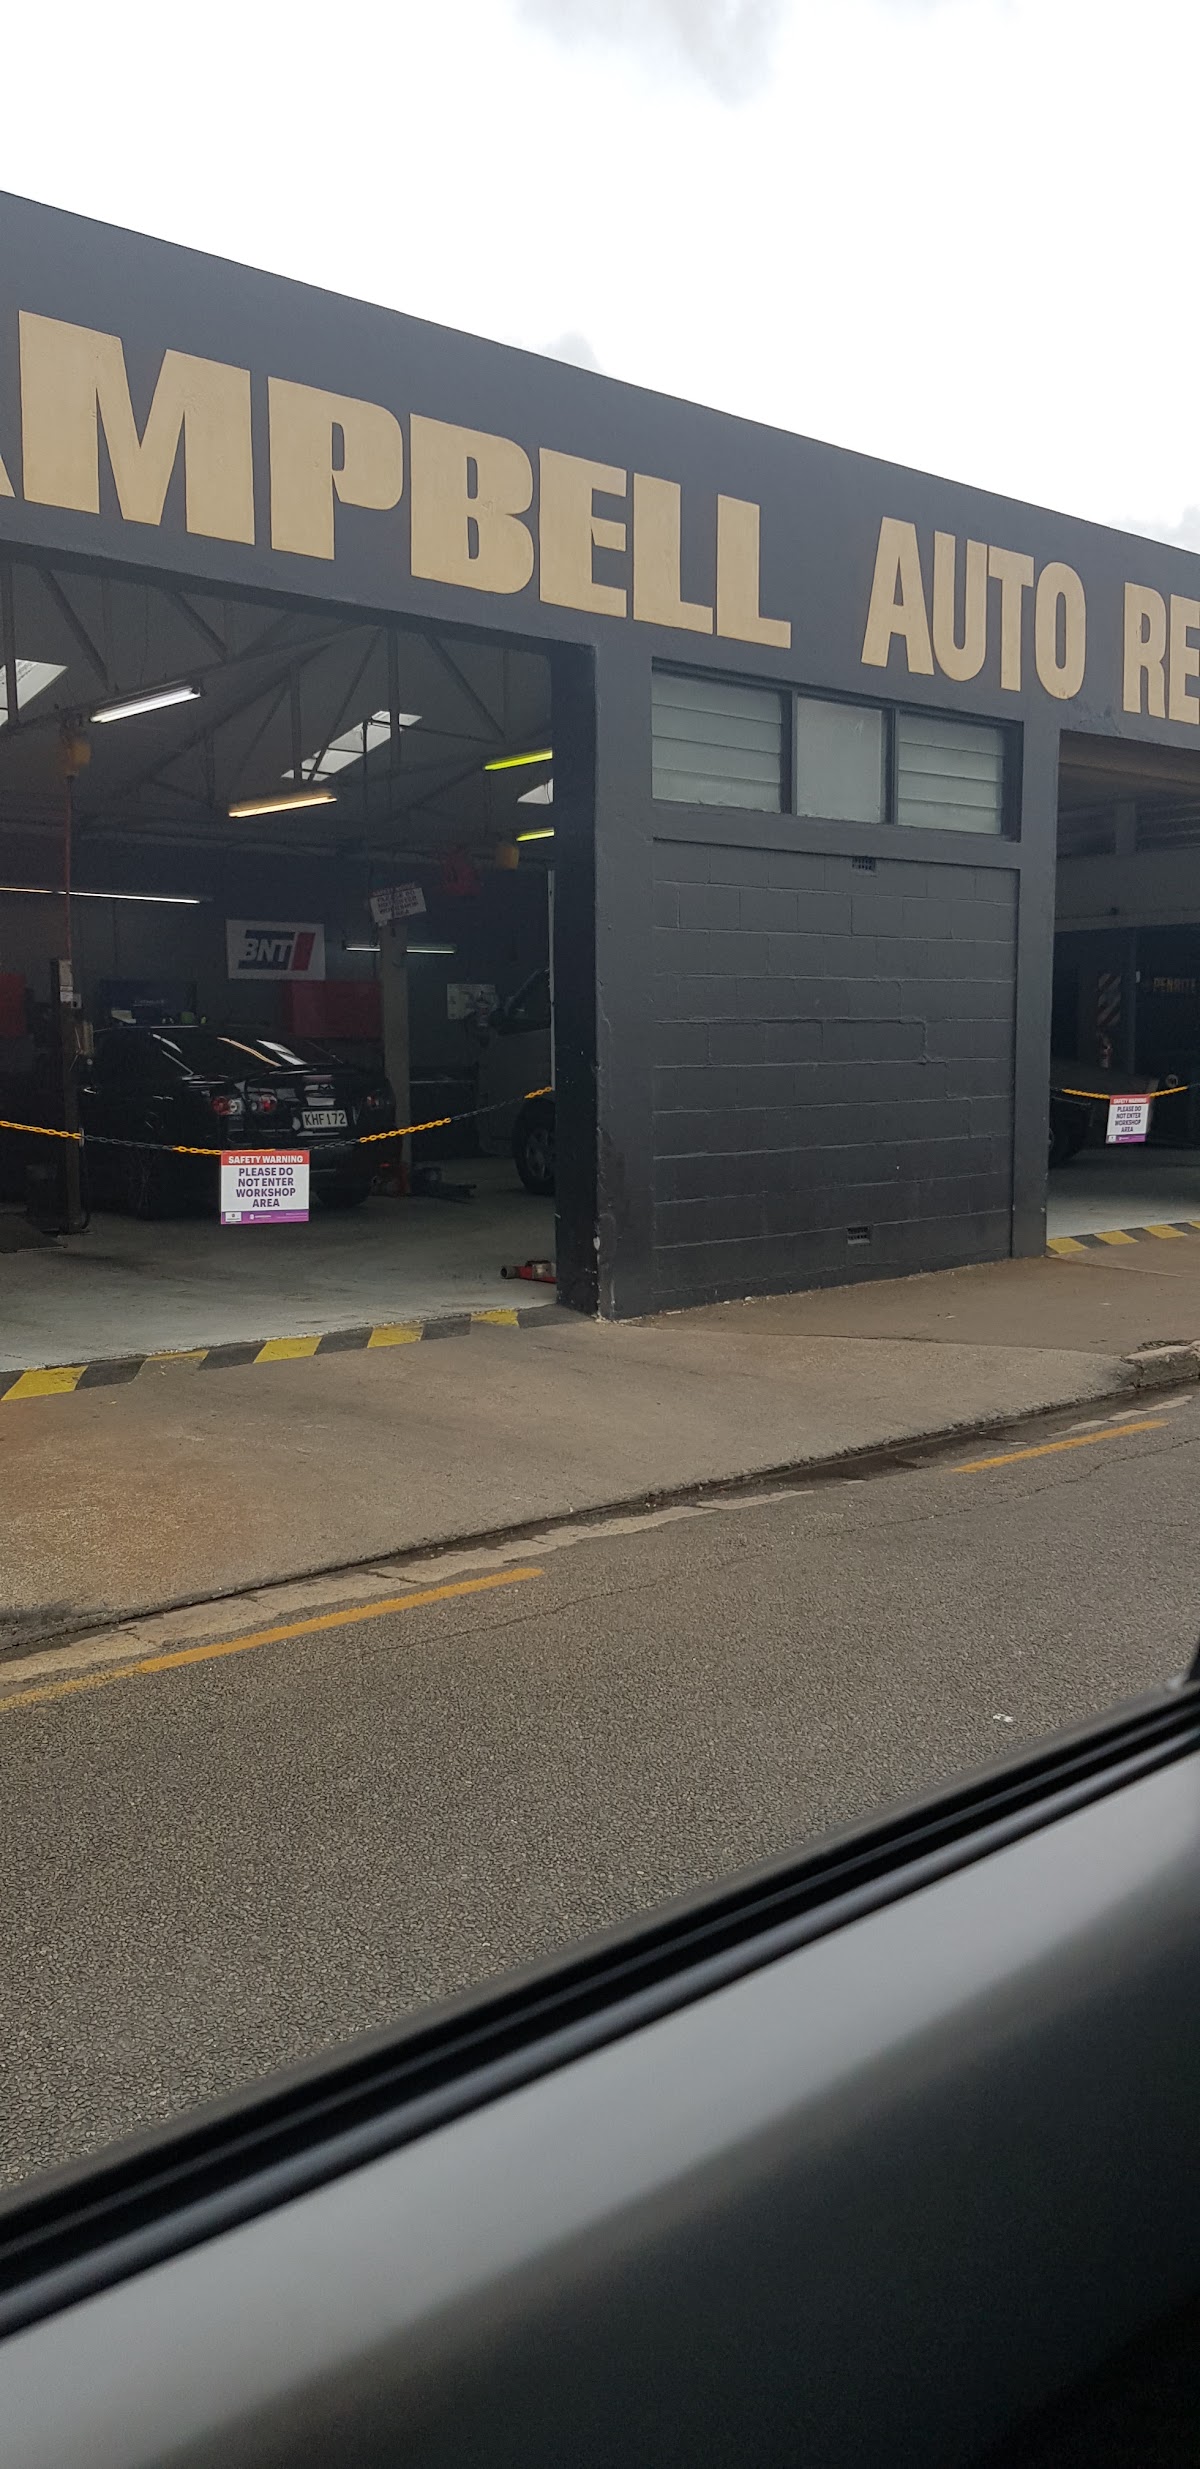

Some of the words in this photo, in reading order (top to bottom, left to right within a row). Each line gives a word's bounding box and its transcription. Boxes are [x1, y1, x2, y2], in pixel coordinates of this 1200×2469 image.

[0, 309, 792, 649] MPBELL
[861, 516, 1087, 700] AUTO
[1123, 582, 1200, 725] RE
[239, 937, 294, 963] BNT
[304, 1112, 346, 1126] KHF172
[228, 1155, 261, 1164] SAFETY
[262, 1155, 303, 1163] WARNING
[238, 1167, 277, 1177] PLEASE
[278, 1167, 294, 1176] DO
[238, 1178, 260, 1187] NOT
[261, 1178, 294, 1187] ENTER
[236, 1187, 296, 1198] WORKSHOP
[252, 1198, 280, 1208] AREA
